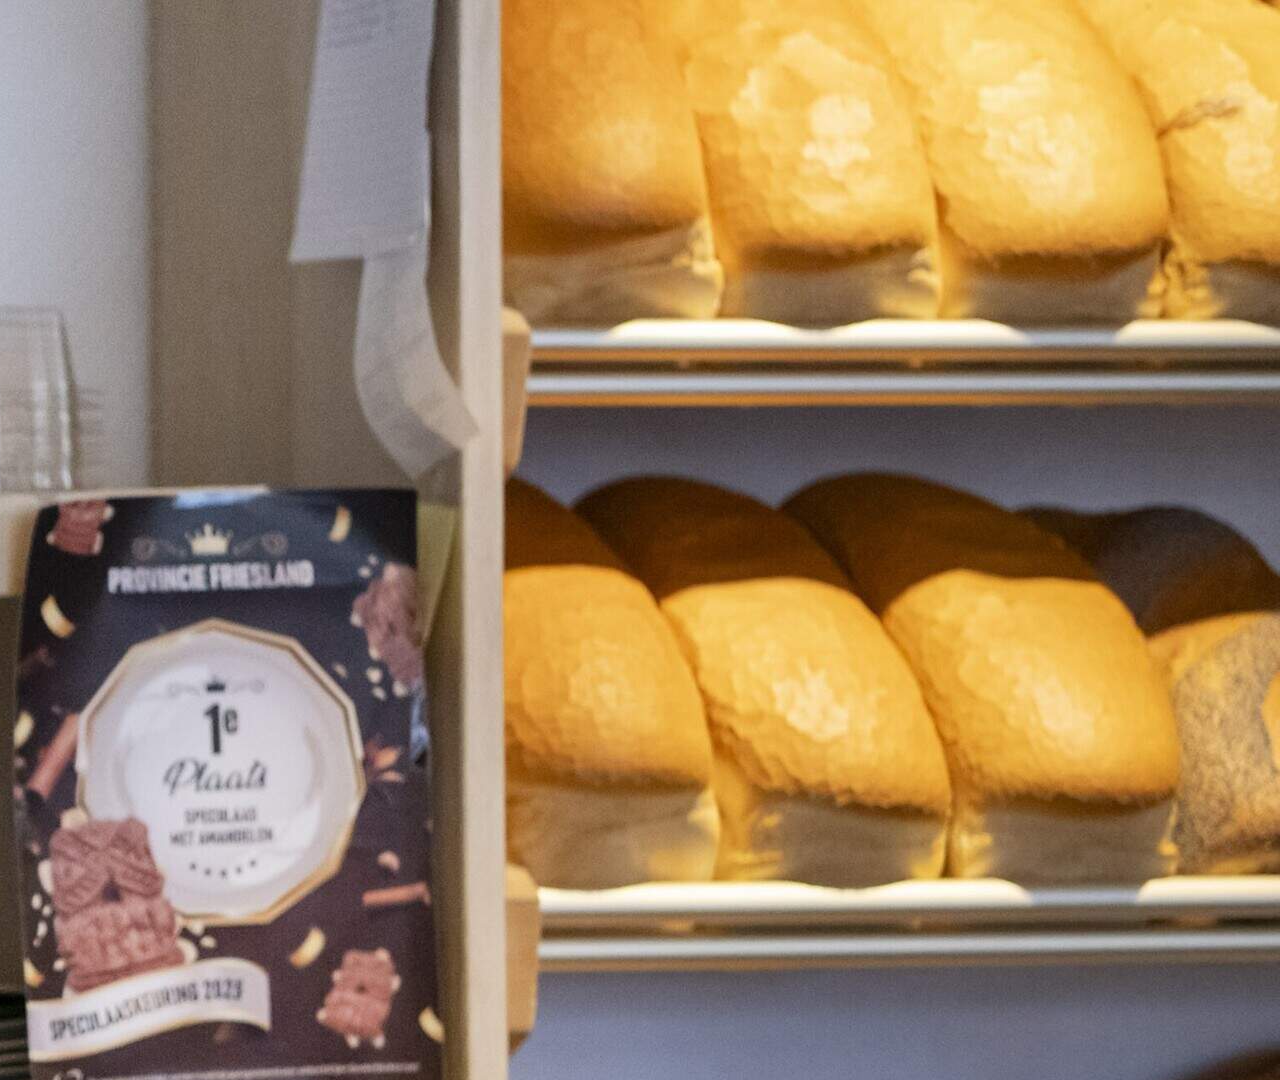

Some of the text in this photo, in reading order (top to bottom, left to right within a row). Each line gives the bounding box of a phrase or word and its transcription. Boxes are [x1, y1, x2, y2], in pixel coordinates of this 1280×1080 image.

[107, 559, 315, 594] PROVINCIE FRIESLAND
[203, 702, 239, 755] 1e
[163, 757, 268, 797] Plaats
[184, 807, 257, 825] SPECULAAS
[169, 830, 194, 847] MET
